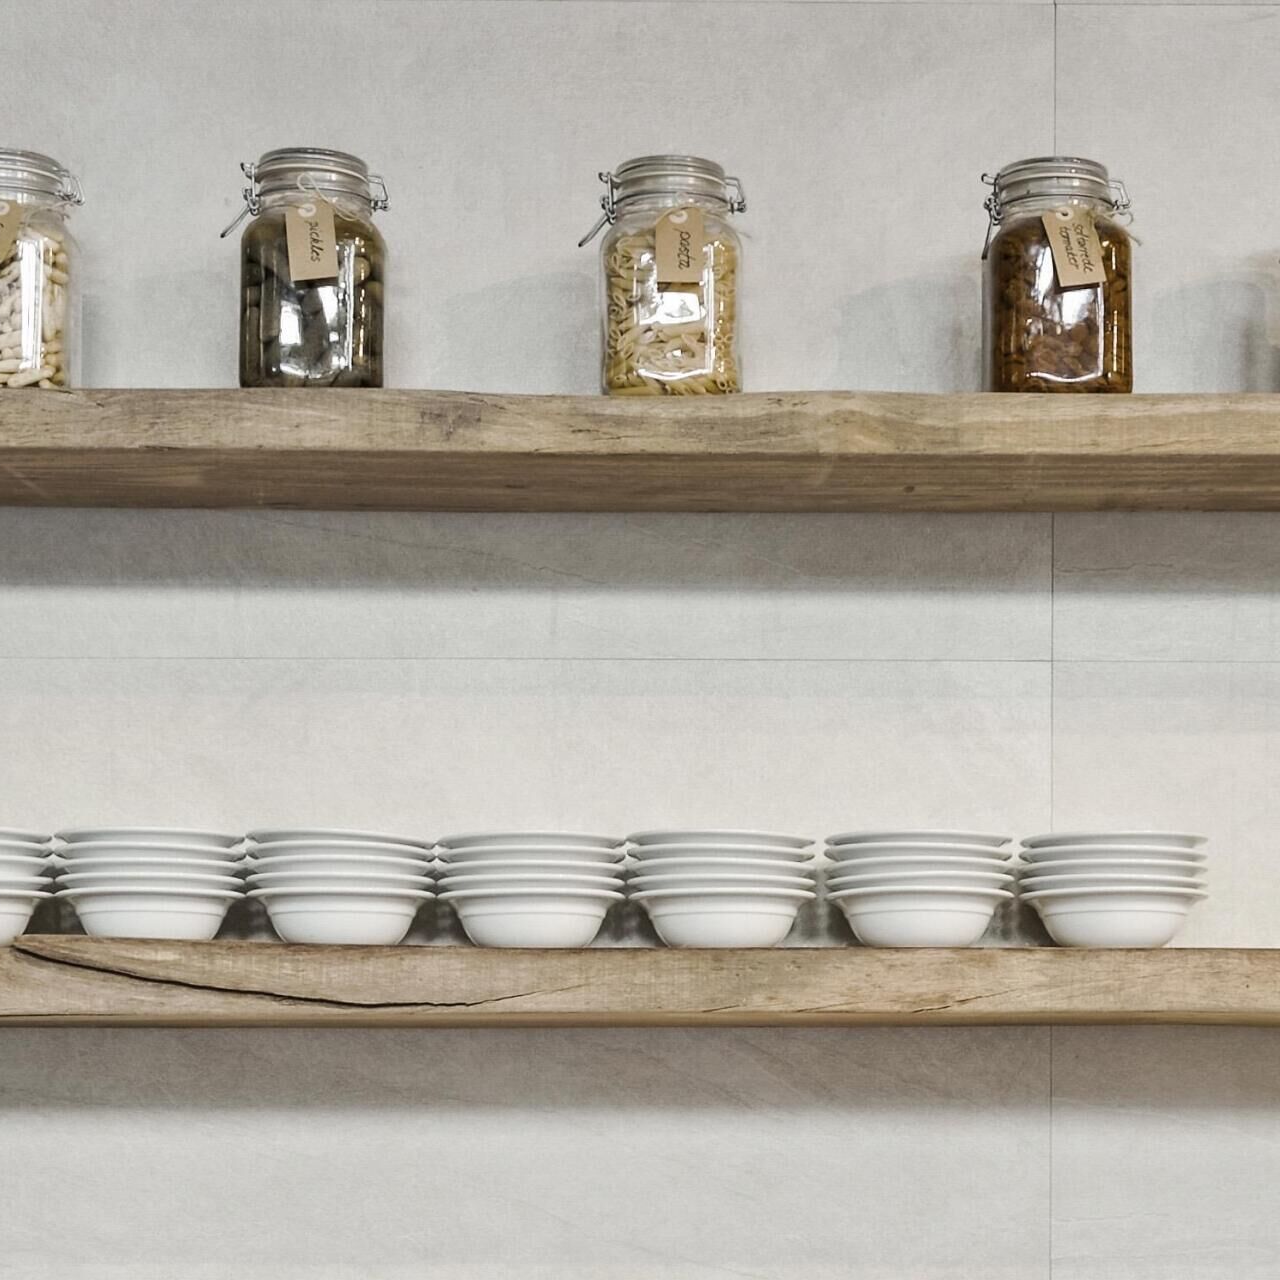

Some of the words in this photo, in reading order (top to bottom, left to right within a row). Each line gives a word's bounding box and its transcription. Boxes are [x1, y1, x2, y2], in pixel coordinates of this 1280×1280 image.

[304, 220, 324, 264] pickles
[674, 228, 696, 271] pasta
[1058, 225, 1079, 271] tomater
